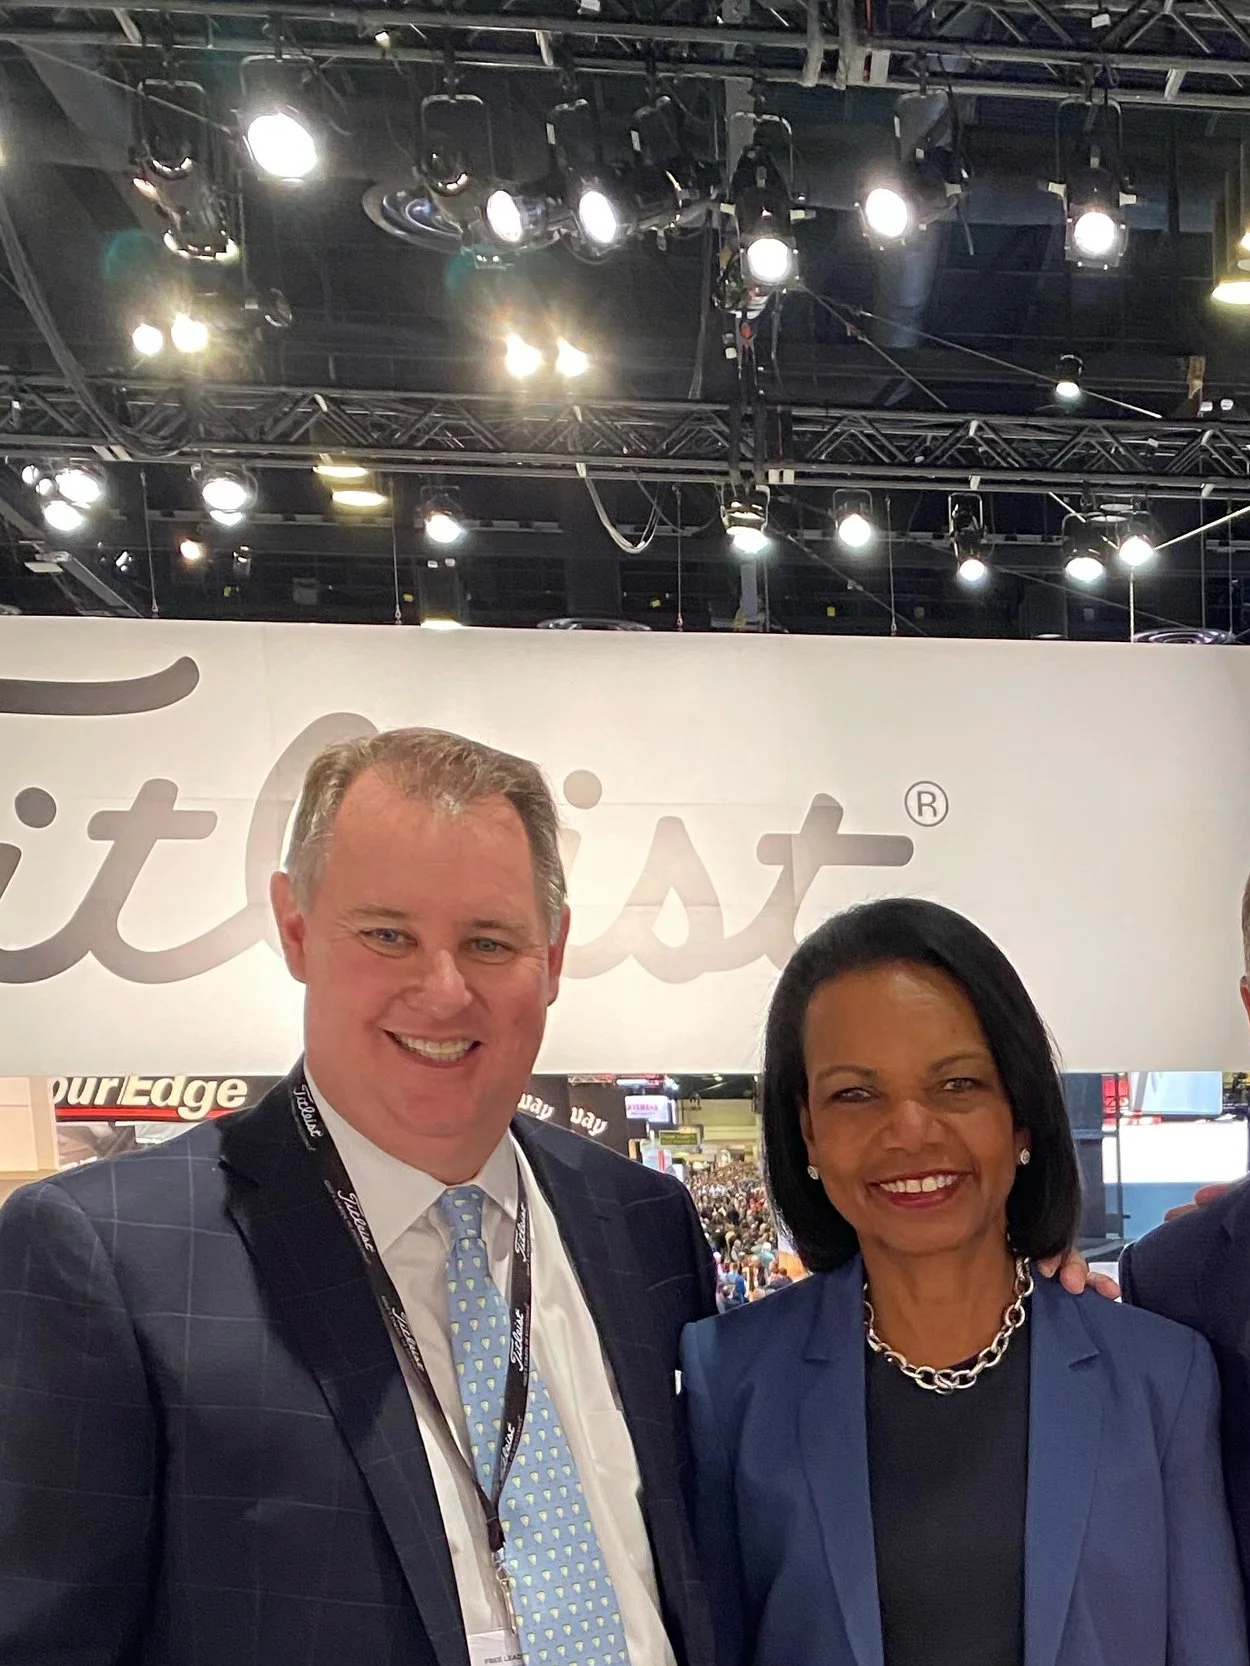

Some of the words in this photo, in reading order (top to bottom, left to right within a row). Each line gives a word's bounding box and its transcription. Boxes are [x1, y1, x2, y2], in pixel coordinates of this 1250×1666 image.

[120, 1075, 248, 1120] Edge
[293, 1084, 323, 1138] Titleist
[338, 1189, 376, 1254] Titleist
